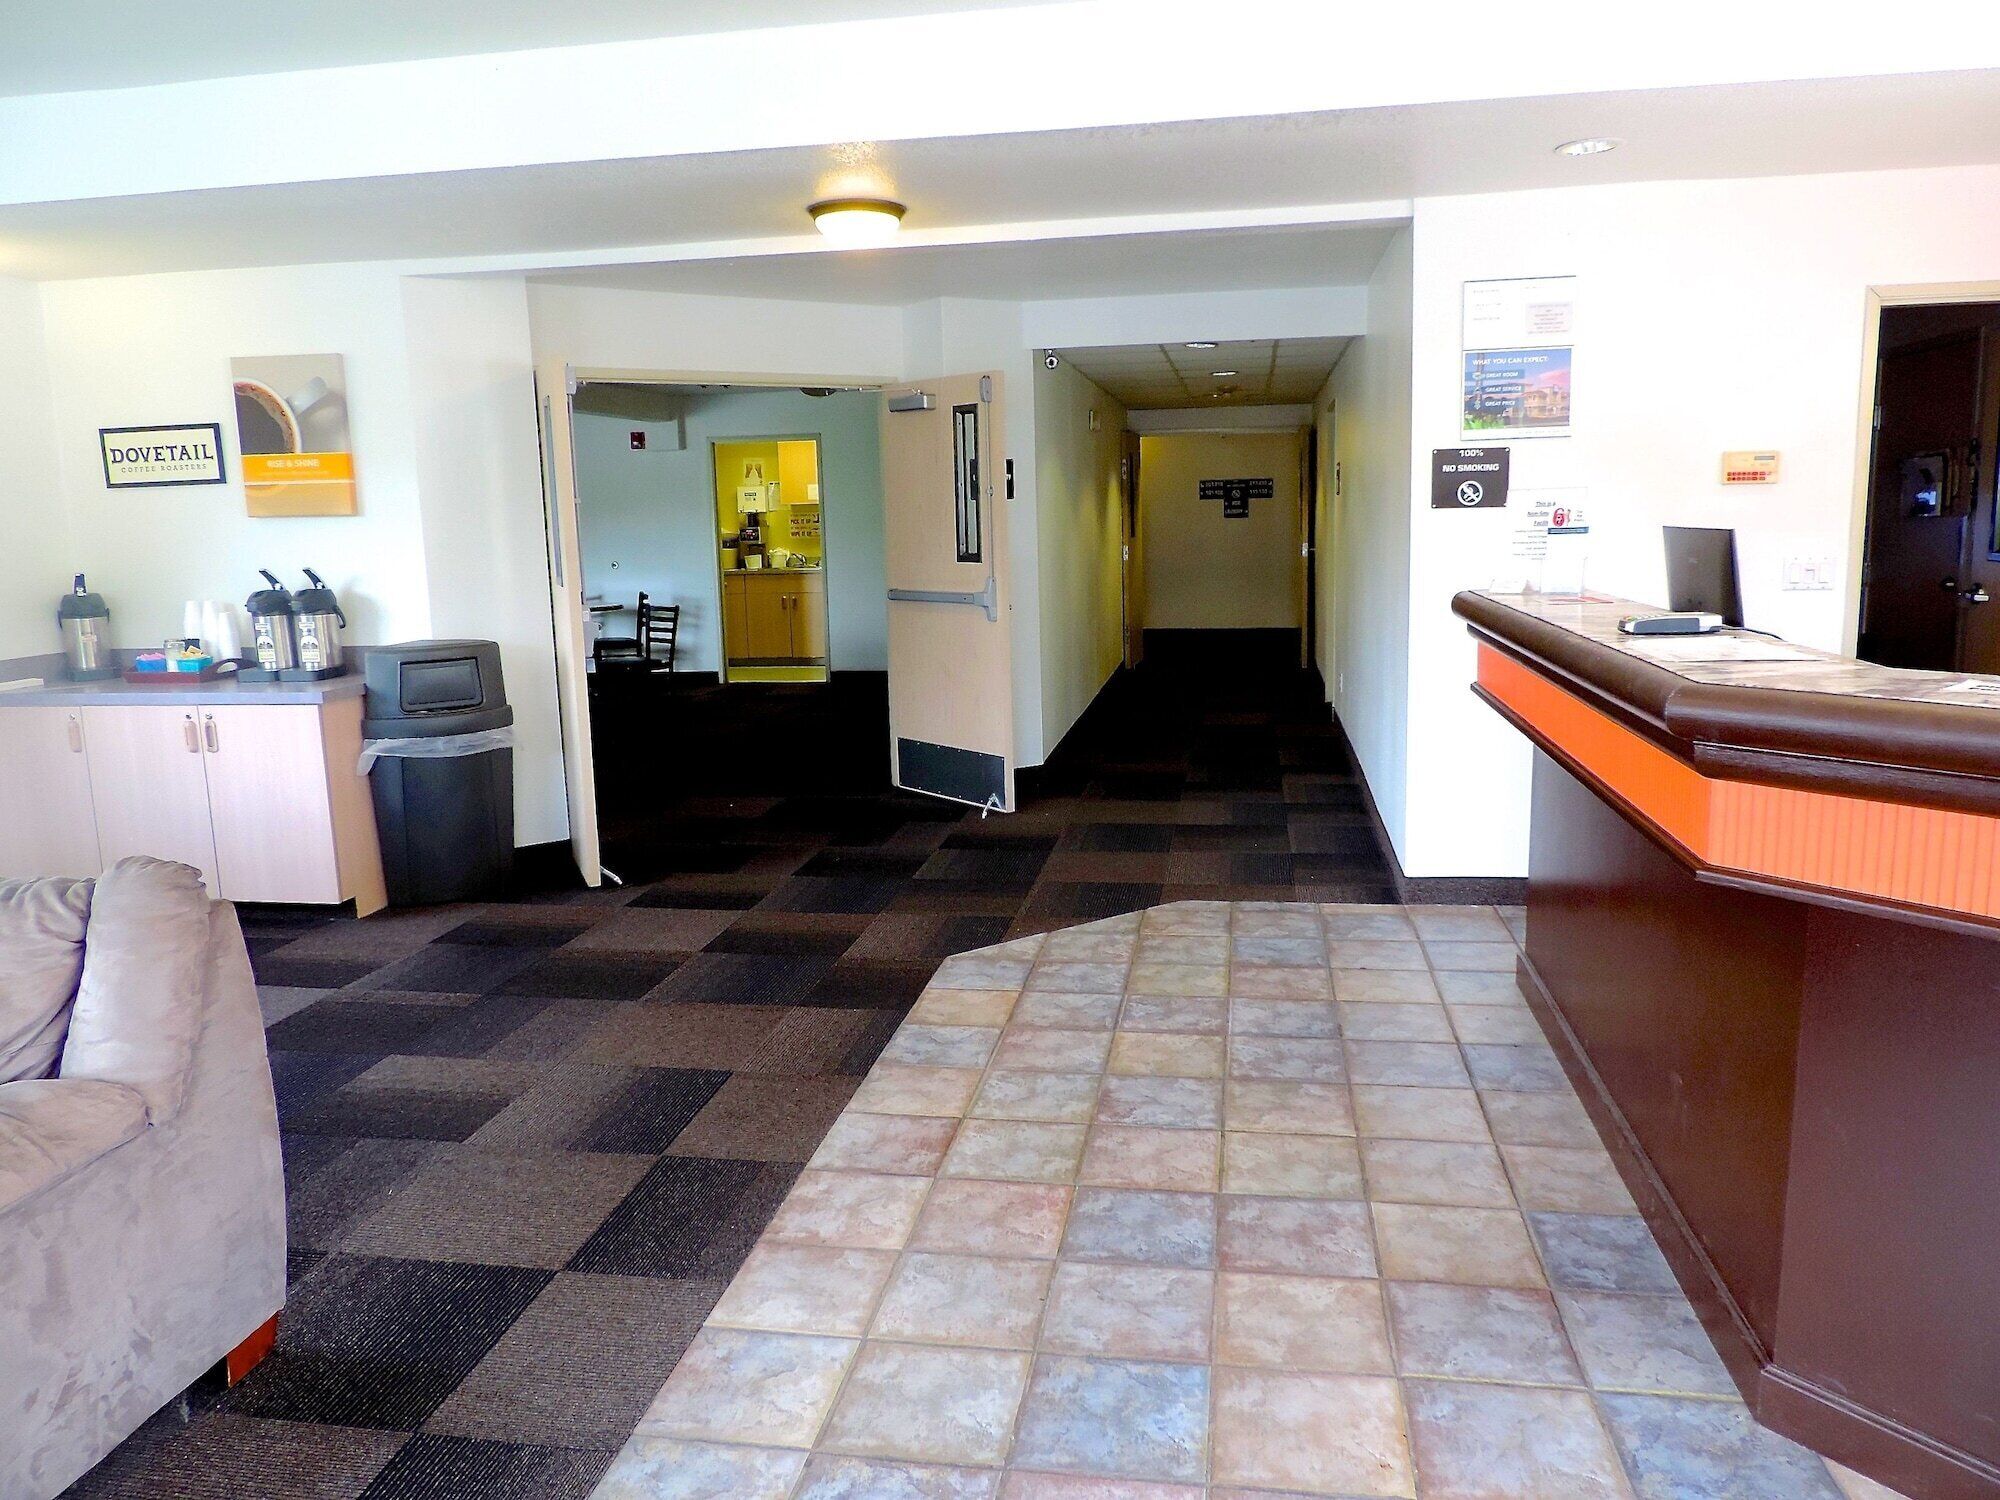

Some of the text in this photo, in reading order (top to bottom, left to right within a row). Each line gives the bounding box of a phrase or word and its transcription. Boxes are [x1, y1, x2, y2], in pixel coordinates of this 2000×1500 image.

[1472, 358, 1491, 366] WHAT
[110, 444, 214, 464] DOVETAIL
[1459, 449, 1484, 457] 100%
[267, 459, 285, 468] RISE
[295, 458, 320, 468] SHINE
[1442, 463, 1500, 473] NO SMOKING
[121, 463, 208, 474] COFFEE ROASTERS
